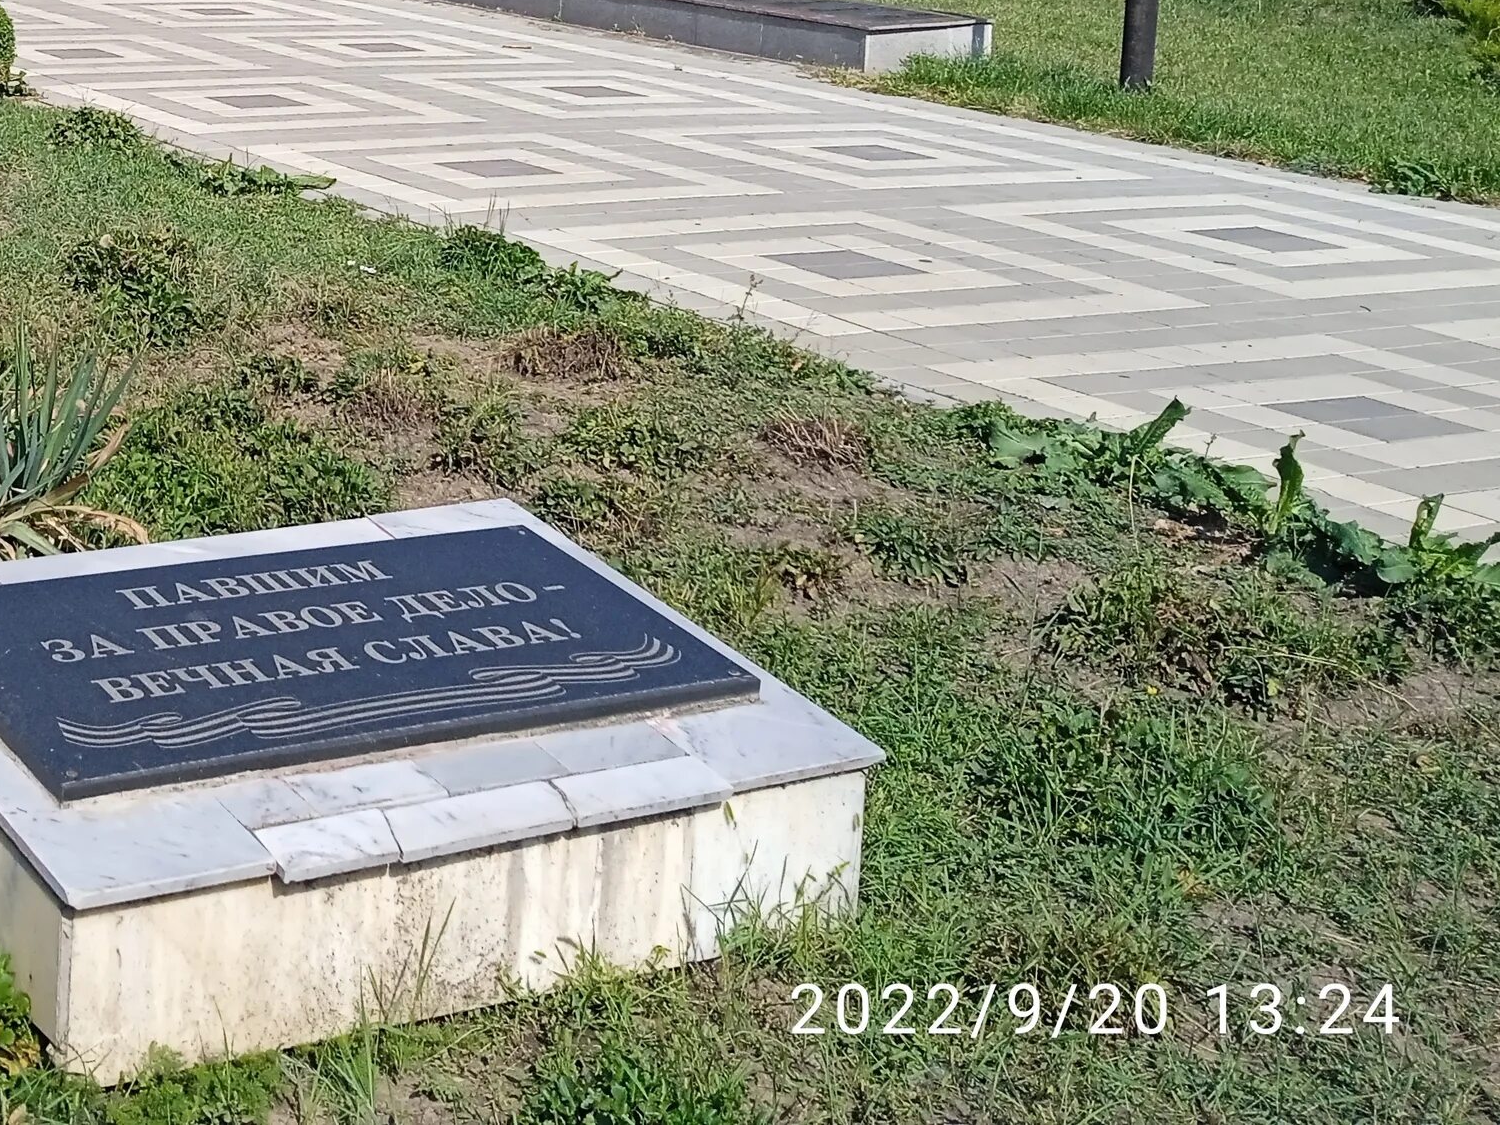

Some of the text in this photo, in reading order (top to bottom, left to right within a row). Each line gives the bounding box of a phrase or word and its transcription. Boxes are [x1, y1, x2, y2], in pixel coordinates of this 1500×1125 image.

[115, 559, 393, 610] ПАВШИМ
[40, 633, 135, 663] ЗА
[136, 600, 384, 651] ПРАВОЕ
[91, 617, 583, 704] ВЕЧНАЯ СЛАВА!
